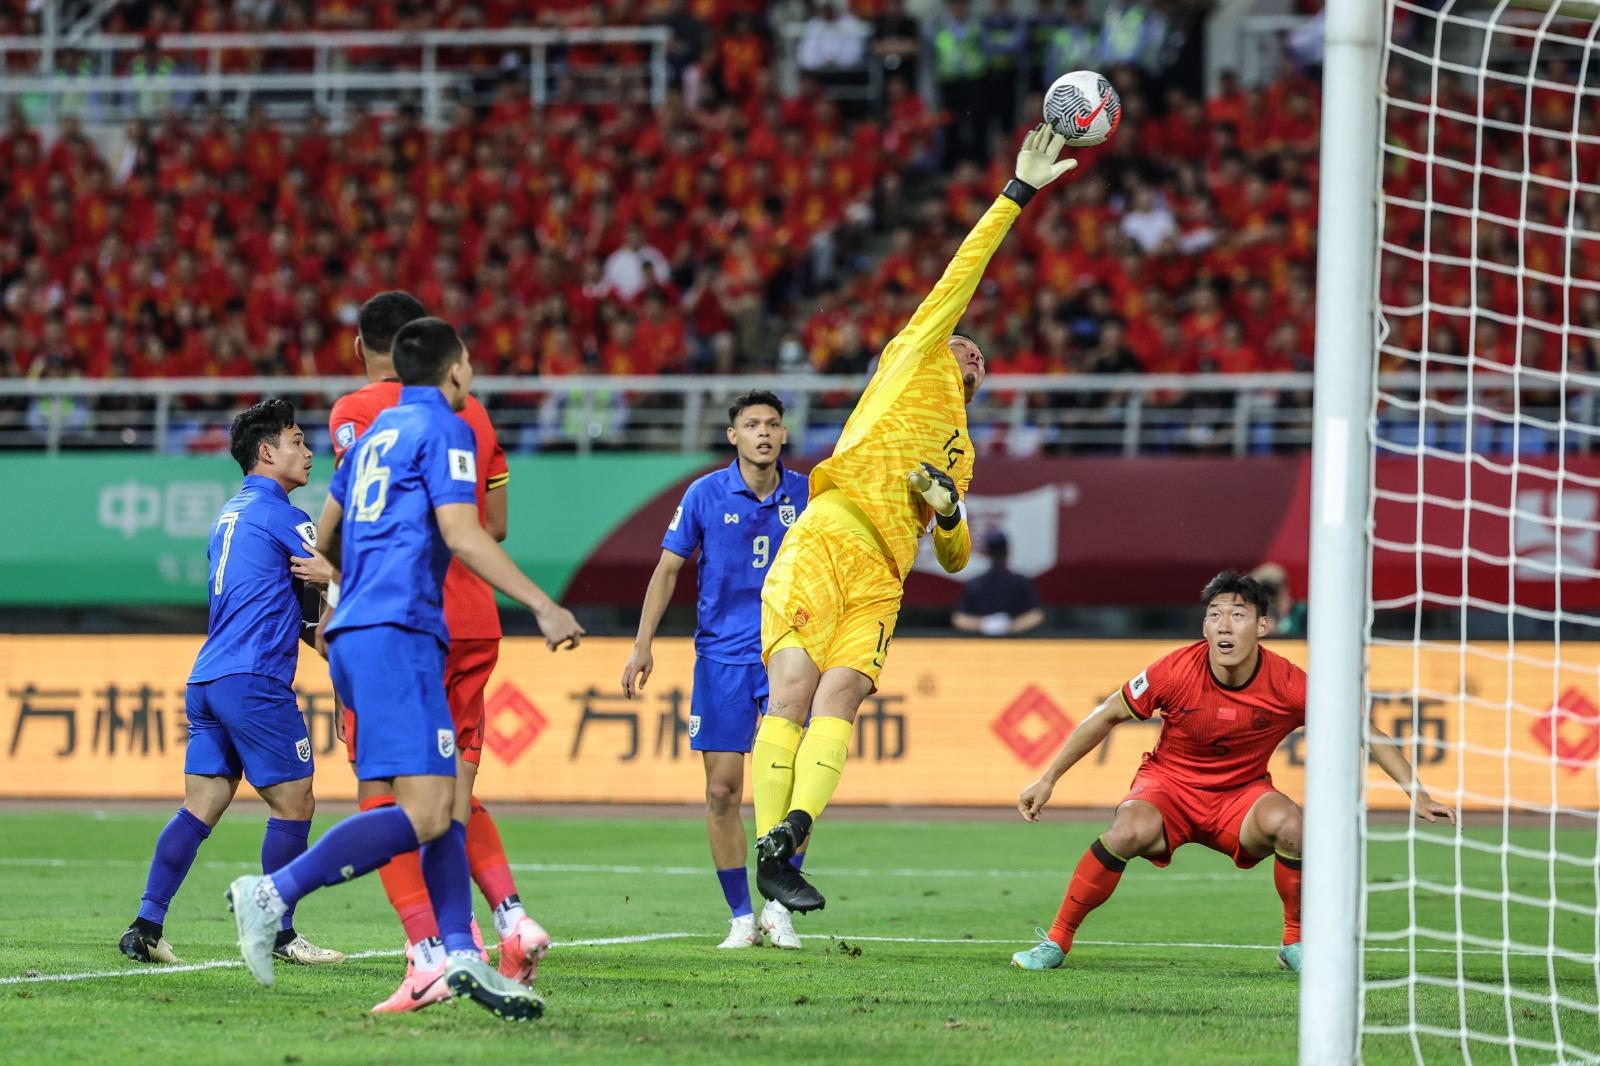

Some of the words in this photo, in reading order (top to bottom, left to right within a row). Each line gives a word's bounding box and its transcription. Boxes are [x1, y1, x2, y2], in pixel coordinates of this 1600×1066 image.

[214, 511, 240, 596] 7
[752, 535, 770, 568] 9
[1211, 736, 1231, 756] 5
